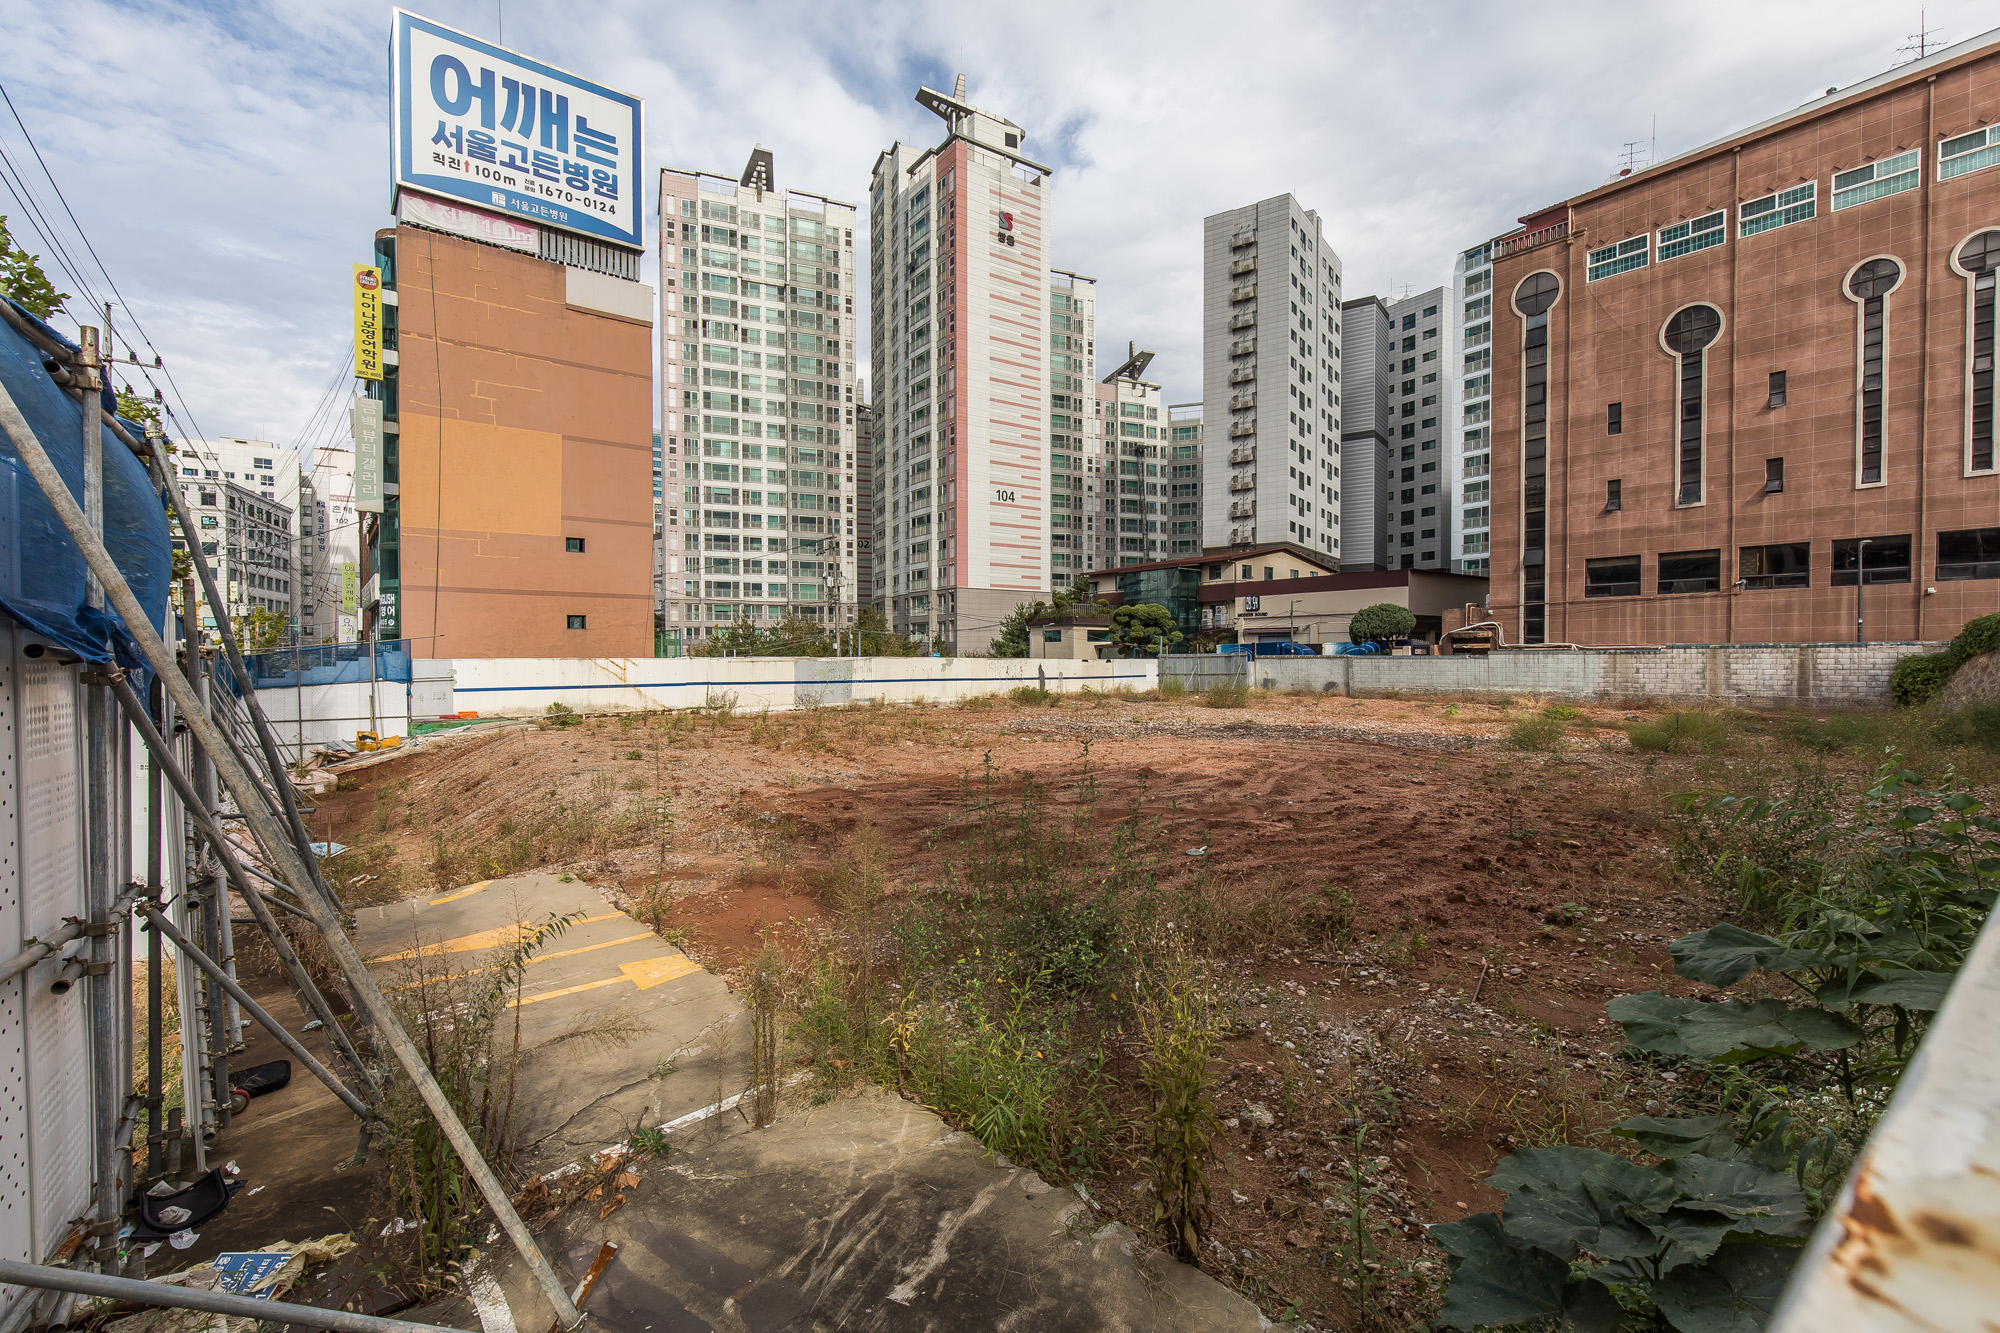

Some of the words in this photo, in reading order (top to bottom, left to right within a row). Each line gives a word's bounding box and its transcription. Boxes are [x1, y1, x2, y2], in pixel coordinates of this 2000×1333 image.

[430, 54, 619, 169] 어깨는
[431, 120, 618, 200] 서울고든병원
[433, 152, 461, 171] 직진
[475, 165, 516, 186] 100m
[510, 197, 568, 222] 서울고든병원
[539, 183, 616, 215] 1670-0124
[361, 292, 377, 370] 다이나모영어학원
[996, 489, 1015, 503] 104
